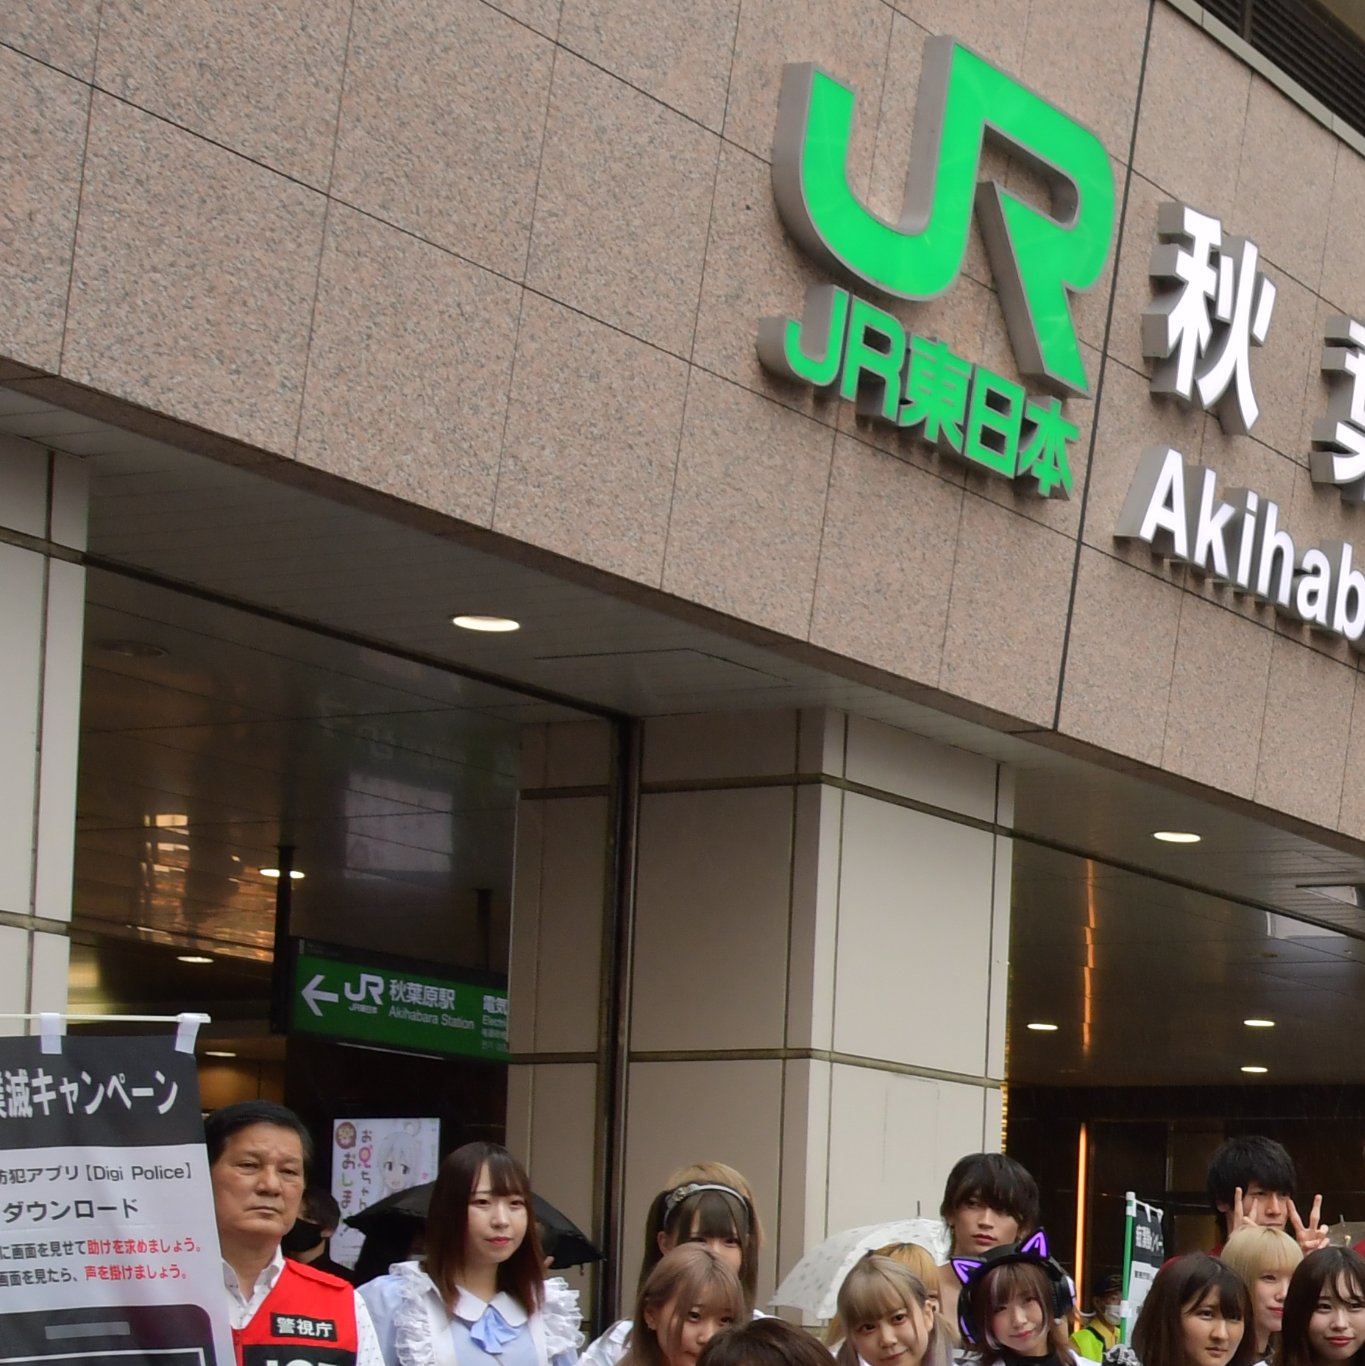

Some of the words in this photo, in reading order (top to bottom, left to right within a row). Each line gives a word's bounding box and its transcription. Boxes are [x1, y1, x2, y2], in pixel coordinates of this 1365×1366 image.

[785, 36, 1115, 398] JR
[774, 286, 1081, 499] JR東日本
[344, 973, 384, 1005] JR
[389, 979, 456, 1010] 秋葉原駅
[388, 1005, 439, 1025] Akihabara
[441, 1014, 475, 1030] Station
[0, 1067, 178, 1118] 滅キャンペーン
[132, 1162, 192, 1181] Police】
[3, 1198, 139, 1224] ダウンロード
[276, 1317, 333, 1338] 警視庁
